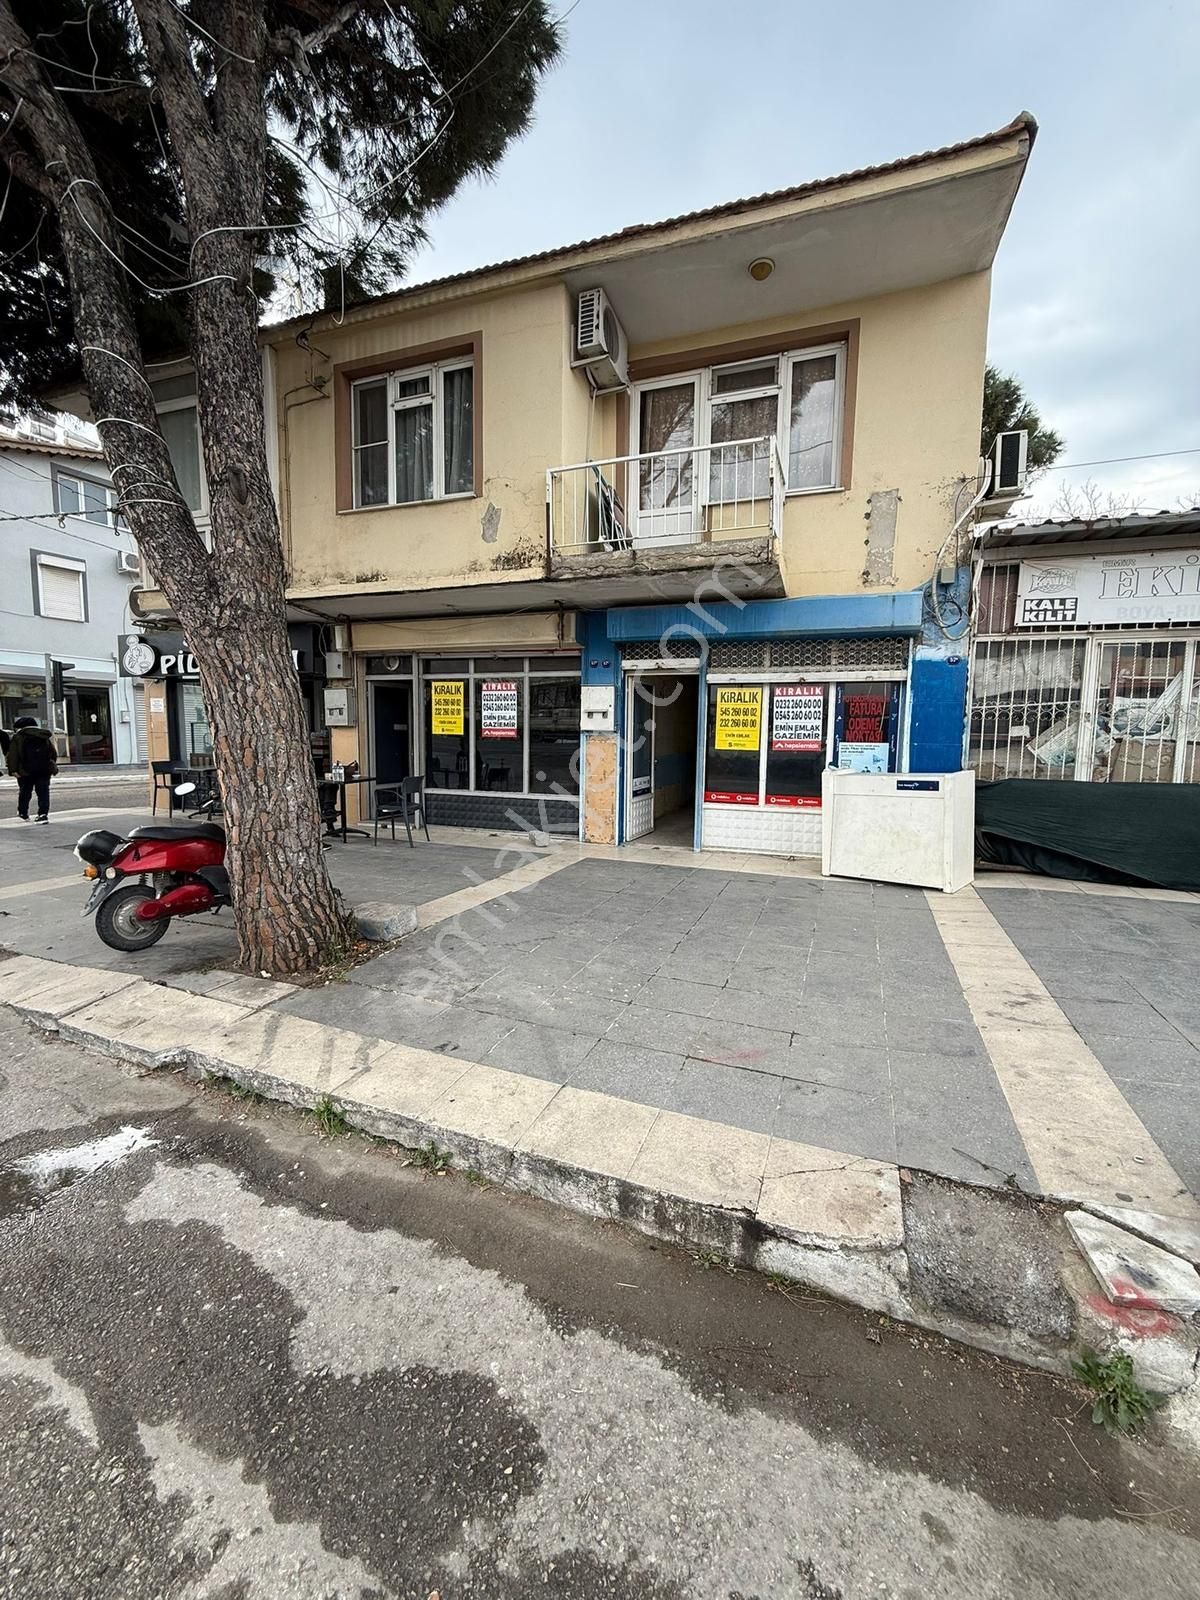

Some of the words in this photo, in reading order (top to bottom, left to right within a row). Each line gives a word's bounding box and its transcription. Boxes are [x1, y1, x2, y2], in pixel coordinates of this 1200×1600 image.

[1025, 599, 1076, 610] KALE
[1117, 604, 1200, 619] BOYA-HI
[775, 699, 790, 709] 0232
[791, 699, 803, 709] 260
[803, 698, 812, 709] 60
[812, 698, 822, 709] 00
[849, 702, 883, 715] FATURA
[720, 708, 731, 716] 545
[731, 708, 742, 716] 260
[742, 708, 750, 716] 60
[750, 708, 758, 716] 02
[775, 711, 790, 720] 0545
[791, 711, 803, 720] 260
[803, 711, 812, 720] 60
[813, 711, 821, 720] 02
[720, 718, 730, 727] 232
[730, 718, 741, 728] 260
[741, 718, 749, 728] 60
[749, 719, 757, 728] 00
[775, 723, 793, 731] EMİN
[775, 731, 820, 739] GAZİEMİR
